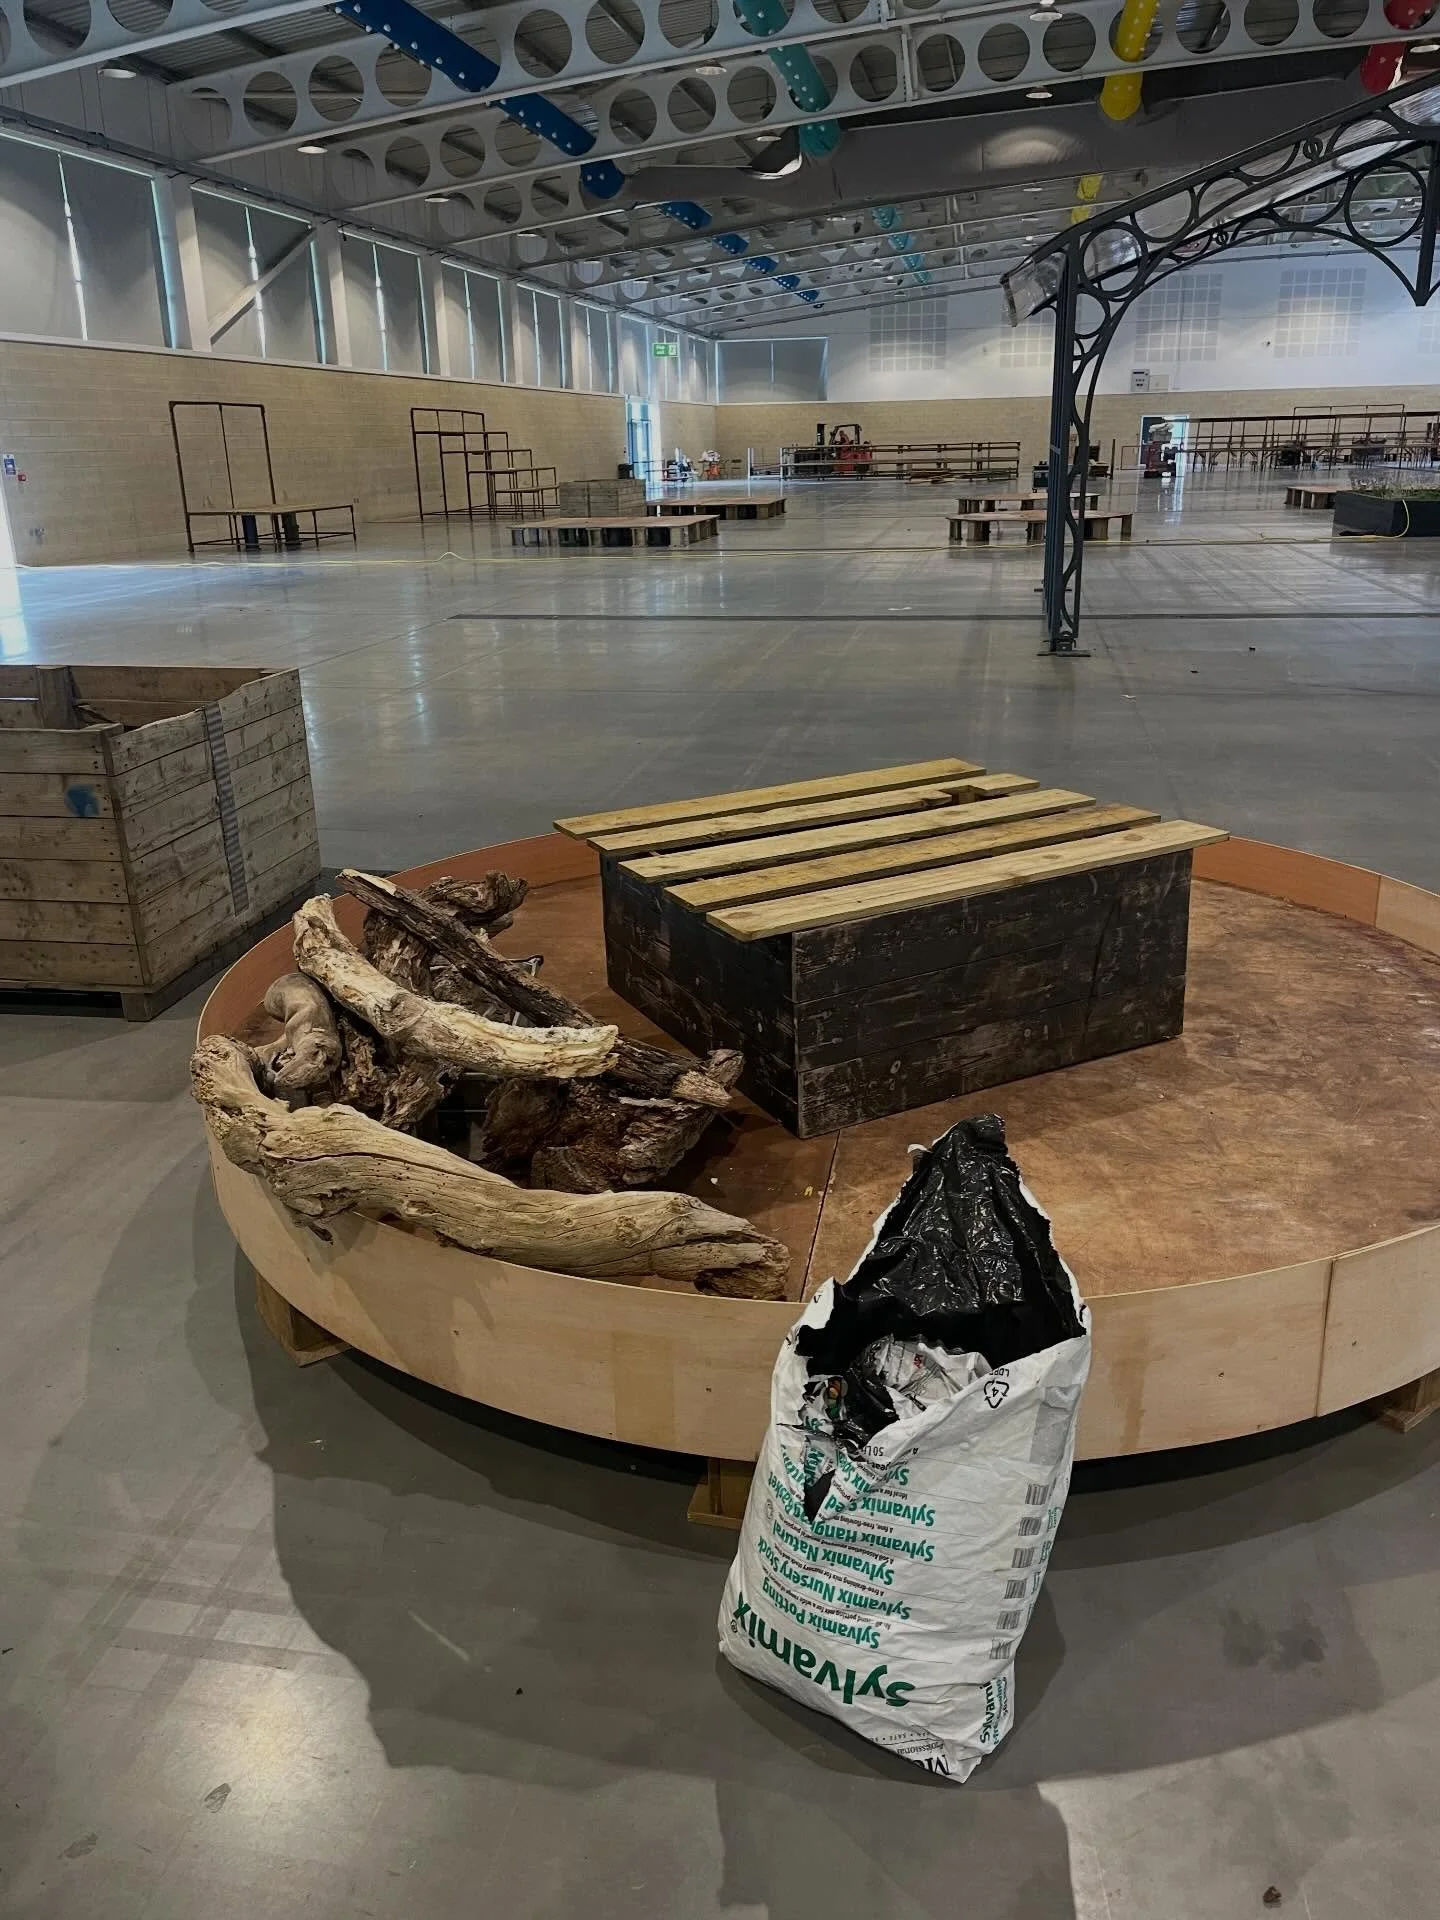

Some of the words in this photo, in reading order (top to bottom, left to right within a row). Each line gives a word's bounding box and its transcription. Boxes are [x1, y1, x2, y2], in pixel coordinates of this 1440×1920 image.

[988, 1368, 1009, 1377] LDP
[990, 1386, 999, 1397] 4
[872, 1446, 884, 1456] 50
[859, 1494, 935, 1526] Sylvamix
[759, 1535, 779, 1572] Stock
[772, 1519, 819, 1562] Natural
[860, 1532, 934, 1561] Sylvamix
[779, 1558, 834, 1601] Nursery
[821, 1548, 895, 1585] Sylvamix
[760, 1576, 806, 1624] Potting
[836, 1589, 910, 1616] Sylvamix
[808, 1612, 881, 1648] Sylvamix
[979, 1681, 994, 1742] Sylvami
